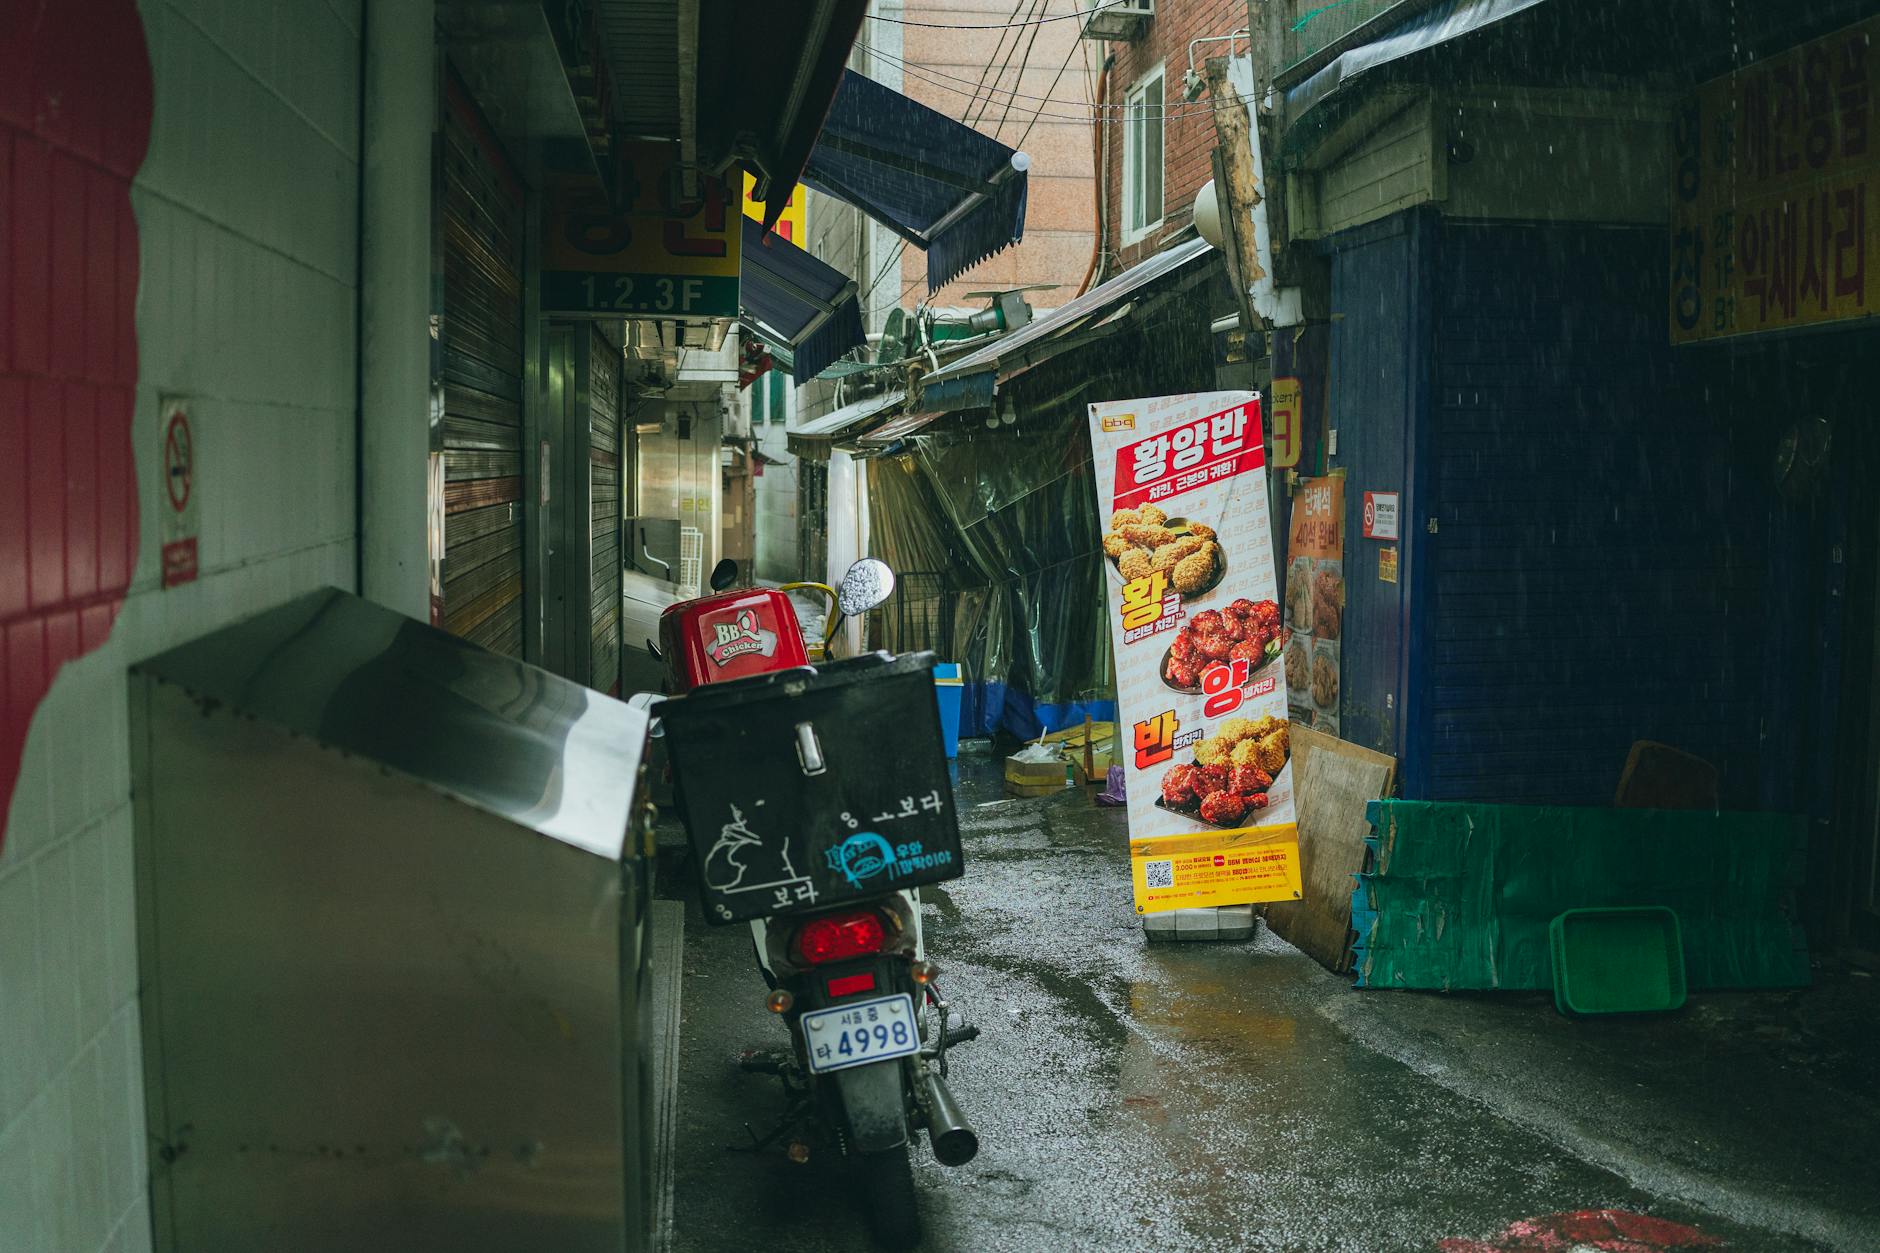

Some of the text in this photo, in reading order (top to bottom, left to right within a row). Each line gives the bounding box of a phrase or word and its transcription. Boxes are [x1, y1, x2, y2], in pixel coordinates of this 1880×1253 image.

[1740, 183, 1865, 321] 악세사리
[1132, 406, 1248, 484] 황양반
[1149, 481, 1175, 501] 치킨,
[1176, 468, 1209, 491] 근본의
[1304, 486, 1332, 518] 단체석
[1295, 520, 1339, 551] 40석 완비
[713, 608, 761, 647] BBQ
[722, 641, 764, 657] Chicken
[841, 1006, 879, 1025] 서울 중
[816, 1020, 909, 1060] 타 4998
